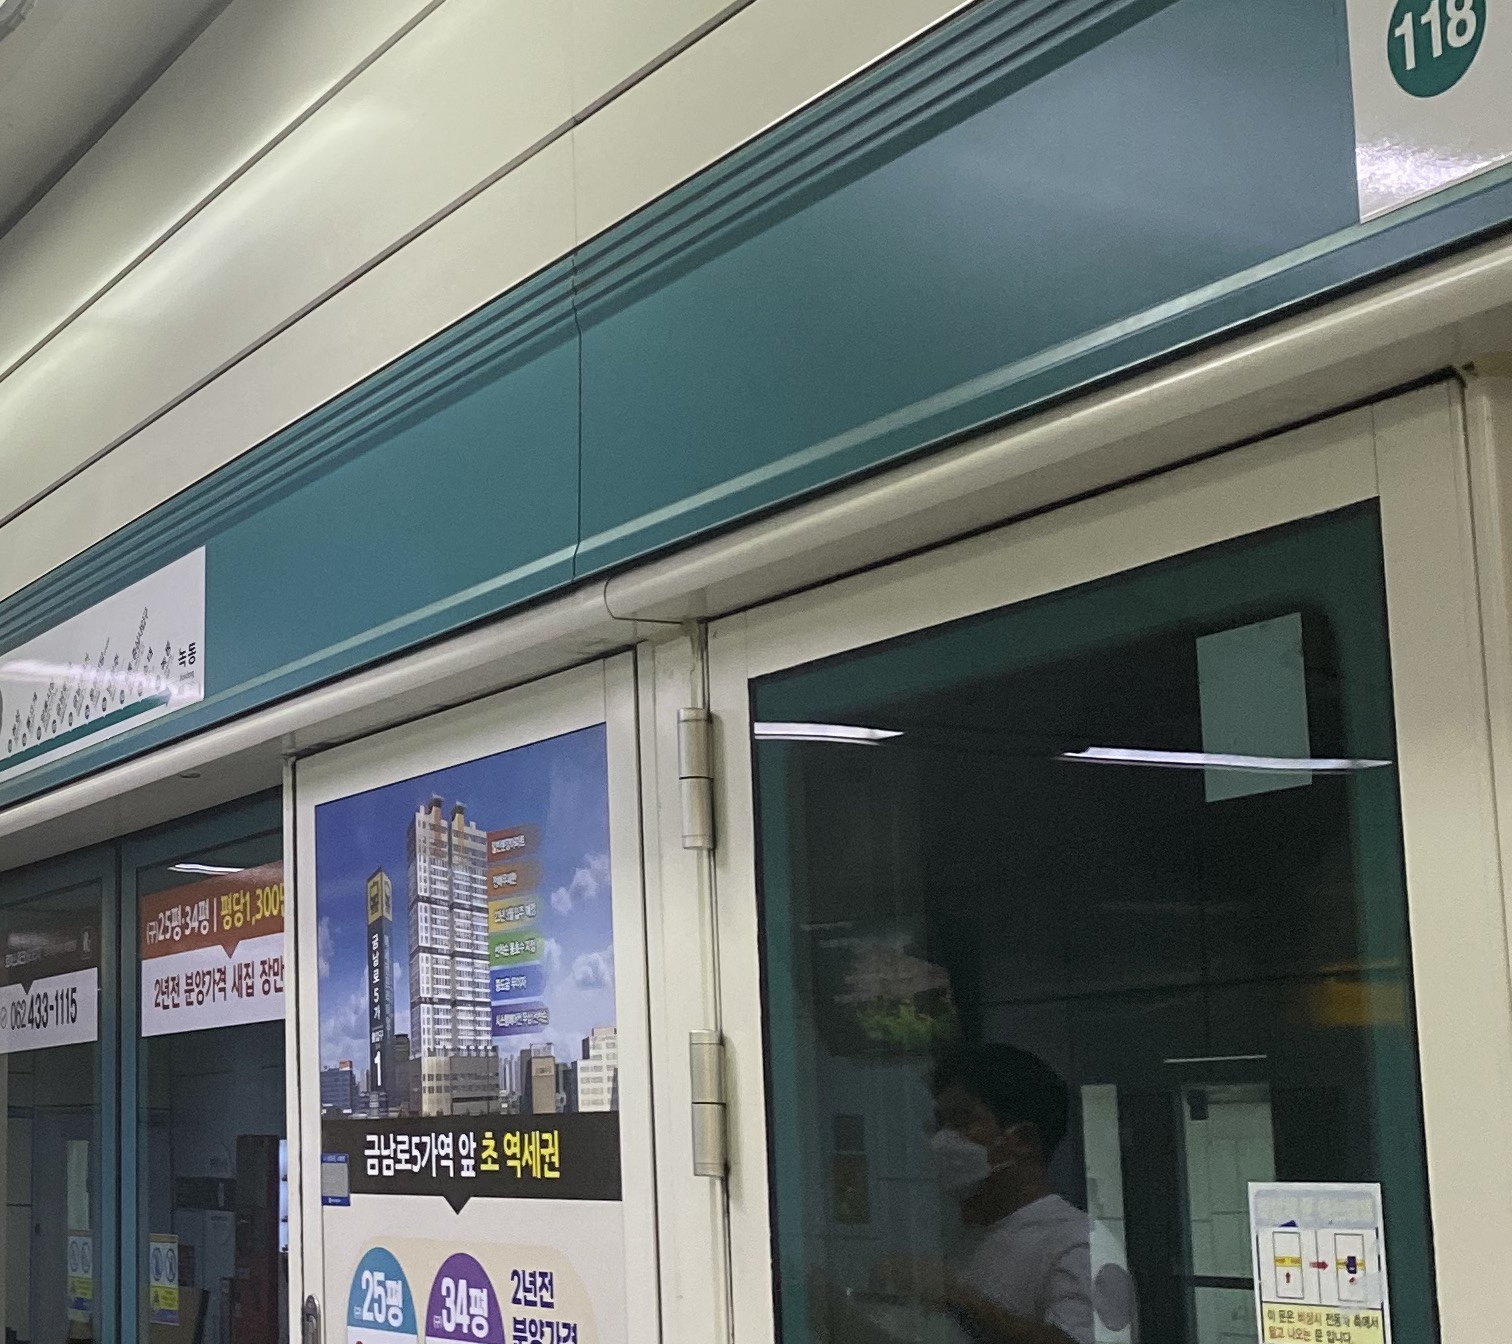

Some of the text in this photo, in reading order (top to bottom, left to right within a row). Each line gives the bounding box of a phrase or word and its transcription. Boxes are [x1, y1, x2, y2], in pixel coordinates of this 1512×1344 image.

[27, 986, 78, 1030] 433-1115
[154, 973, 181, 1010] 2년전
[184, 964, 227, 1007] 분양가격
[231, 959, 256, 1000] 새집
[363, 1129, 561, 1179] 금남로5가역 앞 초 역세권
[510, 1268, 555, 1310] 2년전
